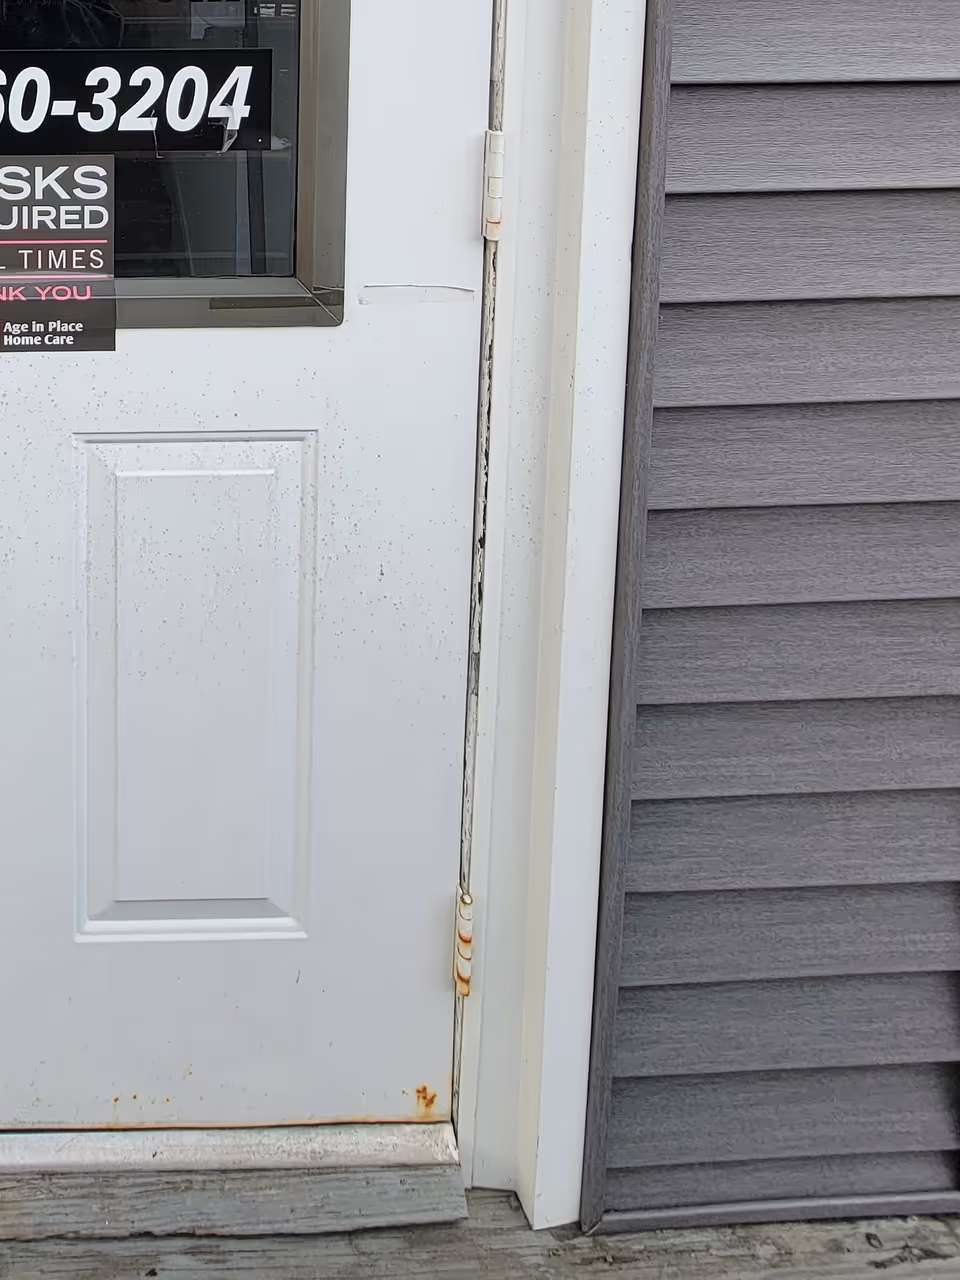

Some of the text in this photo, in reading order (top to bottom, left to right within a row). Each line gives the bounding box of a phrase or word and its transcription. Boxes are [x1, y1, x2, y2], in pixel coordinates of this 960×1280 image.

[21, 248, 105, 270] TIMES
[33, 285, 93, 302] YOU
[3, 319, 84, 335] Age in Place
[3, 333, 74, 346] Home Care
